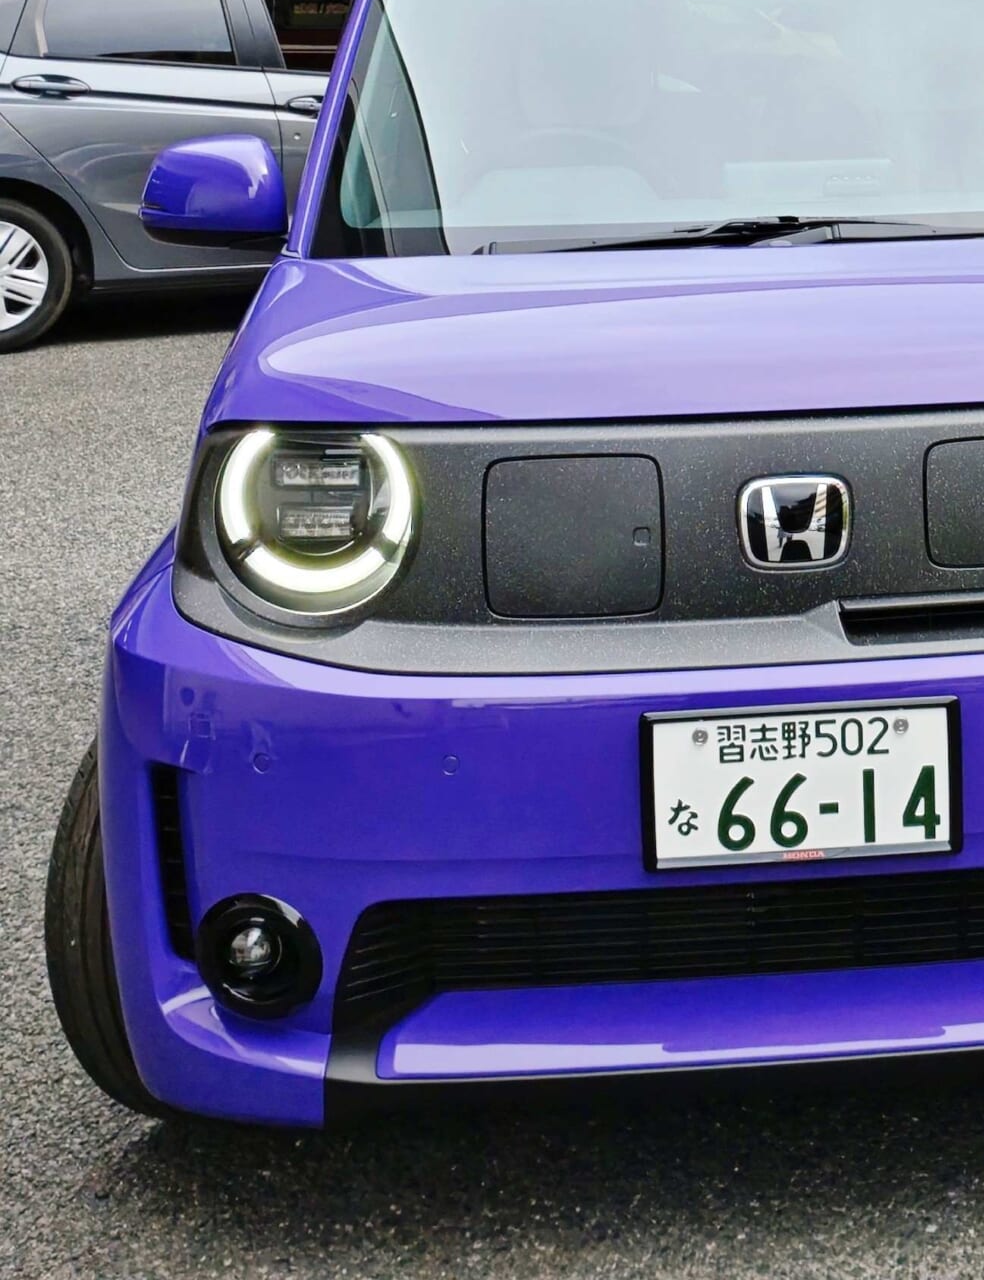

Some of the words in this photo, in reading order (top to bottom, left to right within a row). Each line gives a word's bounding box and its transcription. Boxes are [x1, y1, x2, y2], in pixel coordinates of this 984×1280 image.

[668, 799, 699, 836] な
[717, 765, 941, 851] 66-14
[783, 850, 825, 860] HONDA
